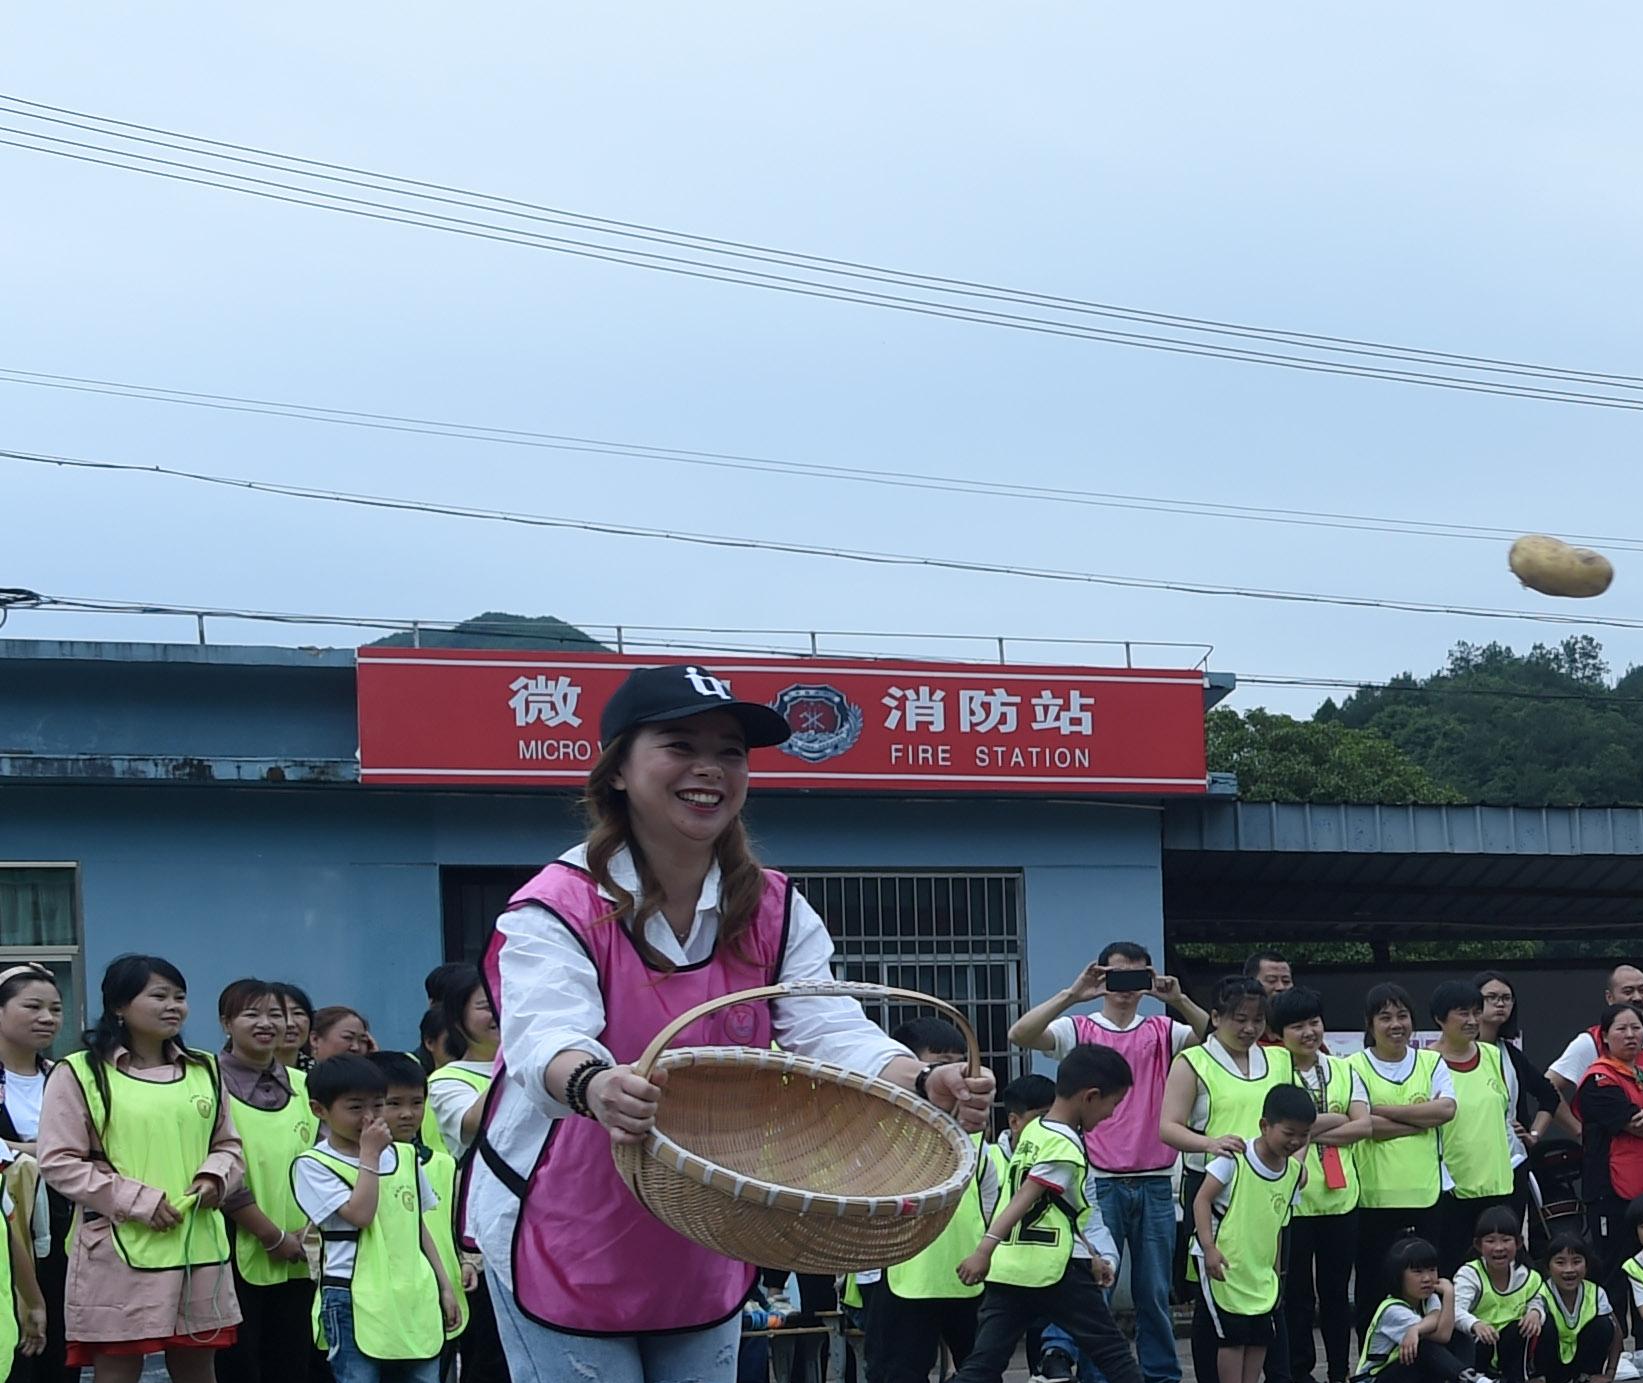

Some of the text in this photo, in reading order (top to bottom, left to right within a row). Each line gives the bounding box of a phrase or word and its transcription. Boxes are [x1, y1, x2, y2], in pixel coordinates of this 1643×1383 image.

[508, 674, 1095, 736] 微 消防站
[518, 739, 592, 761] MICRO
[890, 743, 1090, 769] FIRE STATION
